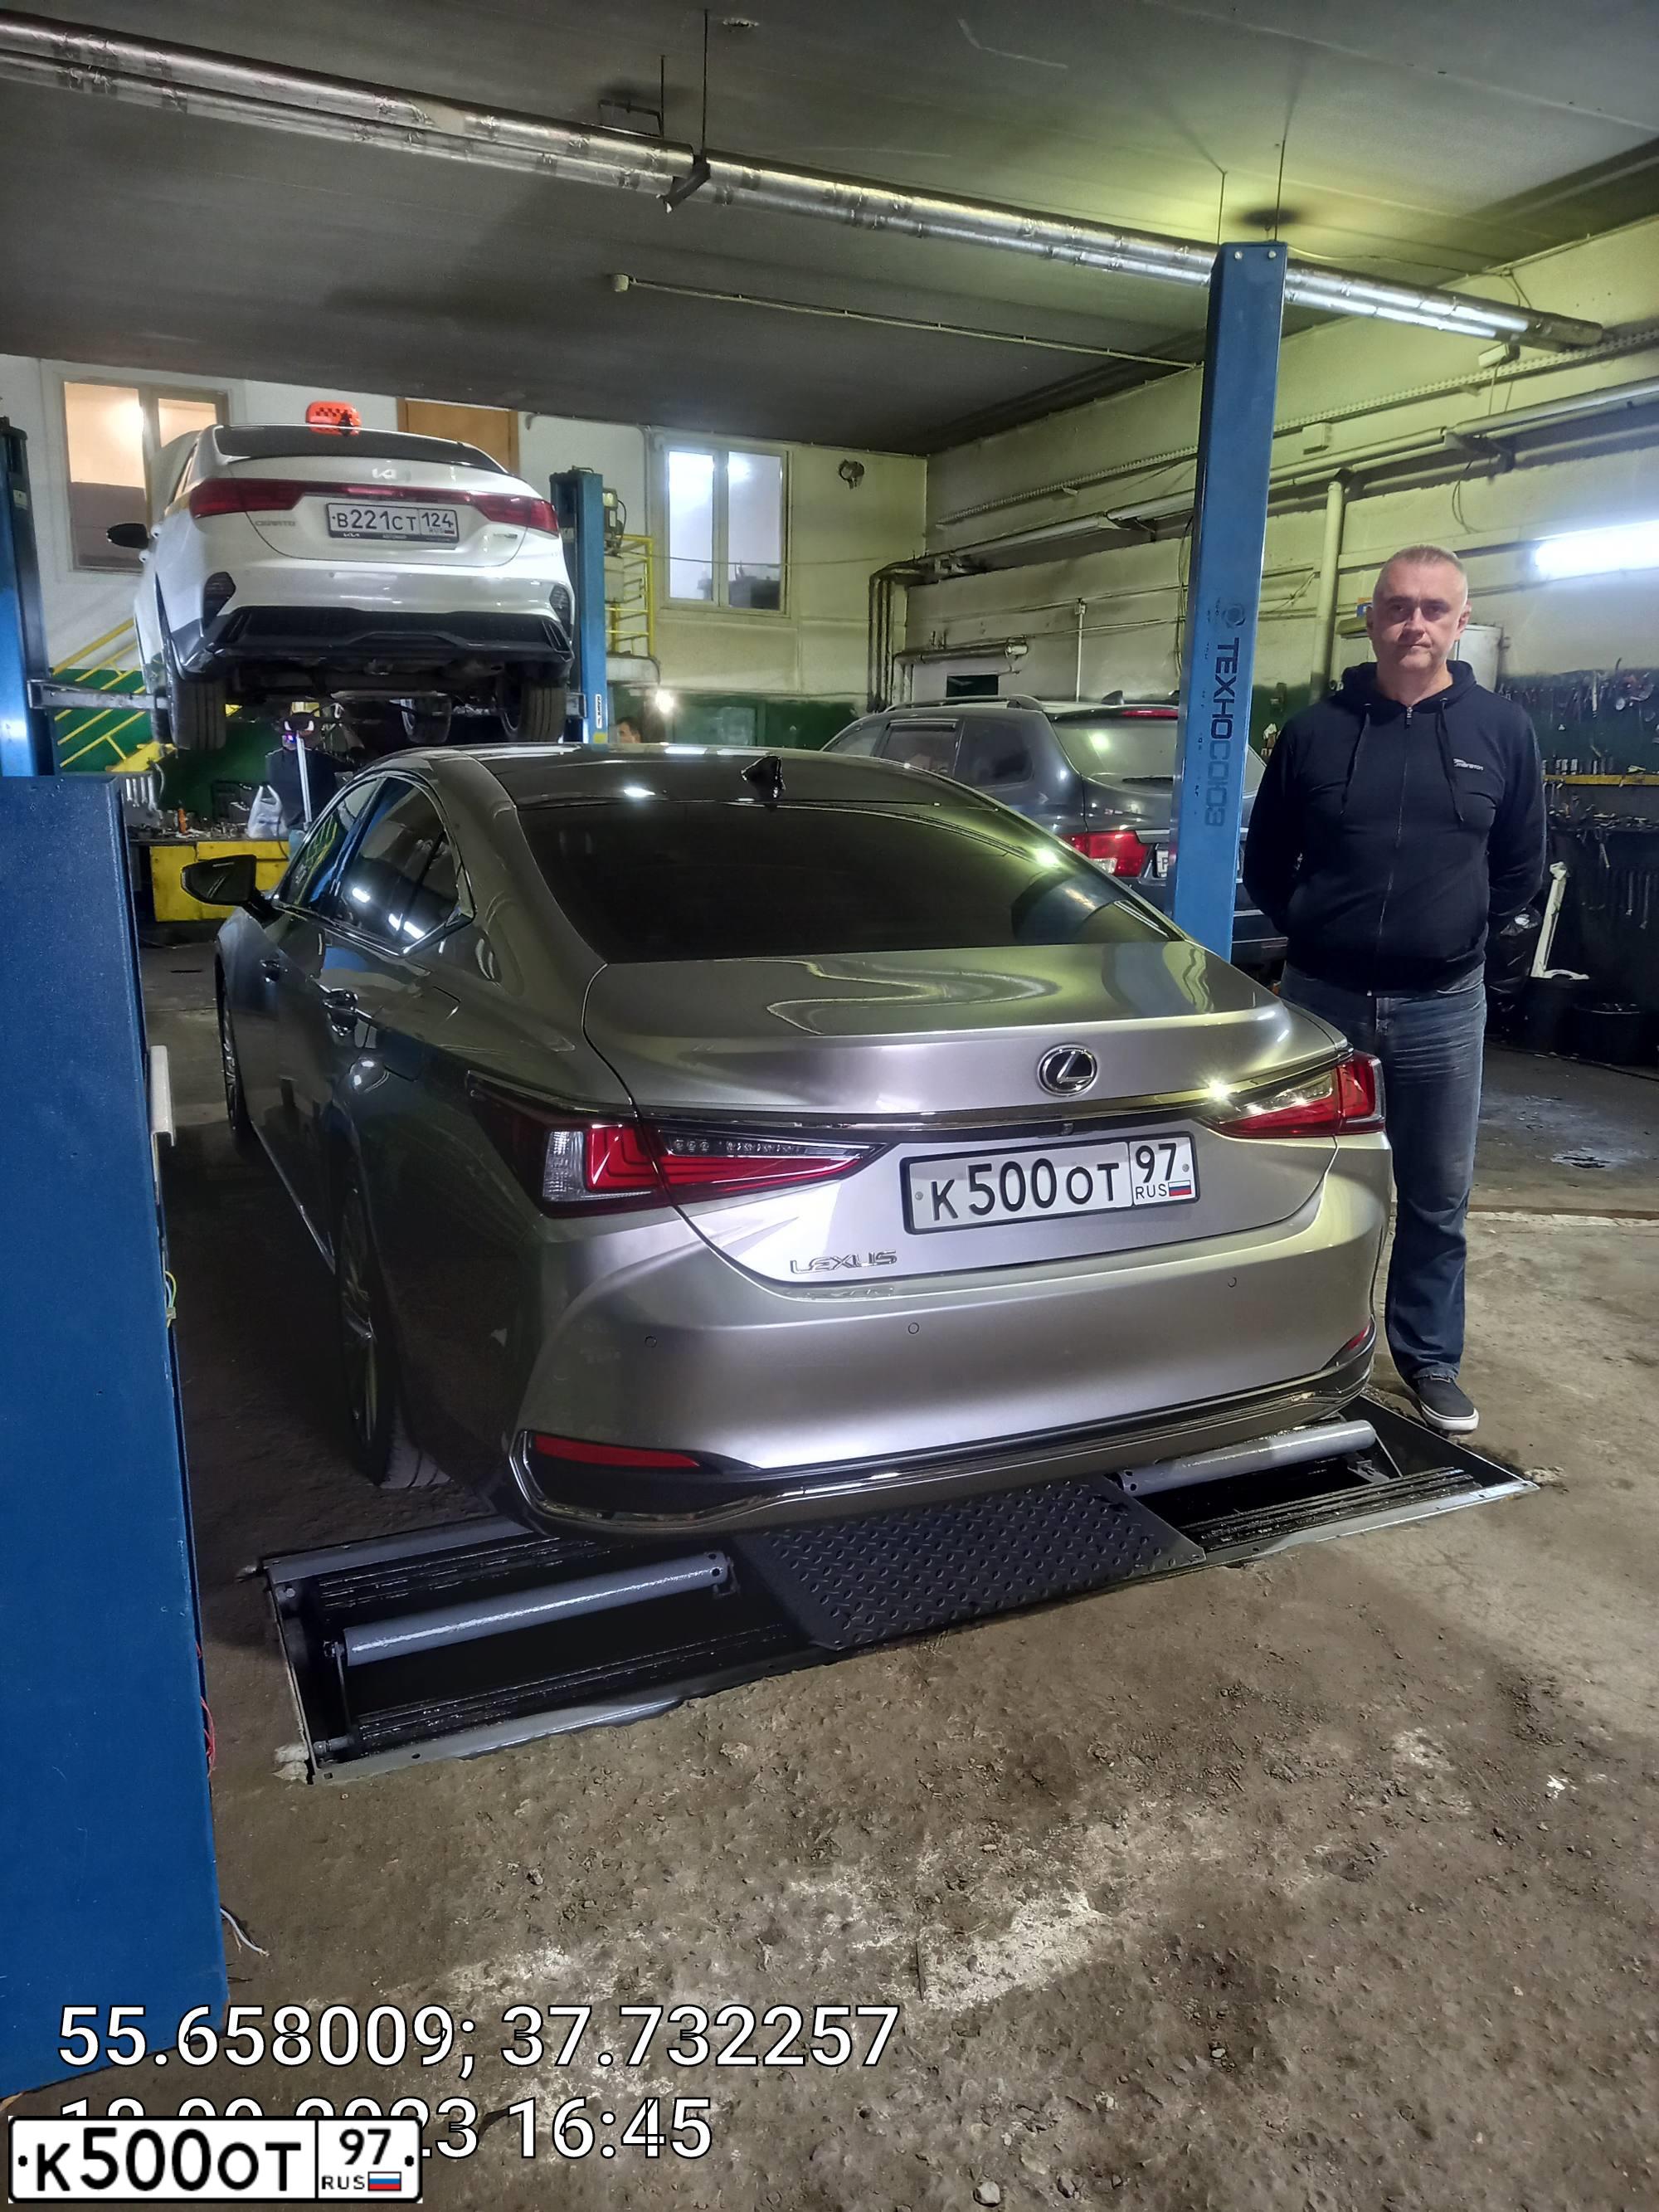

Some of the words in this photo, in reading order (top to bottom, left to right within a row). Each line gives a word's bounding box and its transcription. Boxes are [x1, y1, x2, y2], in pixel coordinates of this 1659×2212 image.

[421, 512, 454, 528] 124
[930, 1158, 1120, 1220] К500ОТ
[1135, 1143, 1177, 1183] 97
[1136, 1183, 1167, 1200] RUS
[790, 1250, 898, 1274] LEXUS
